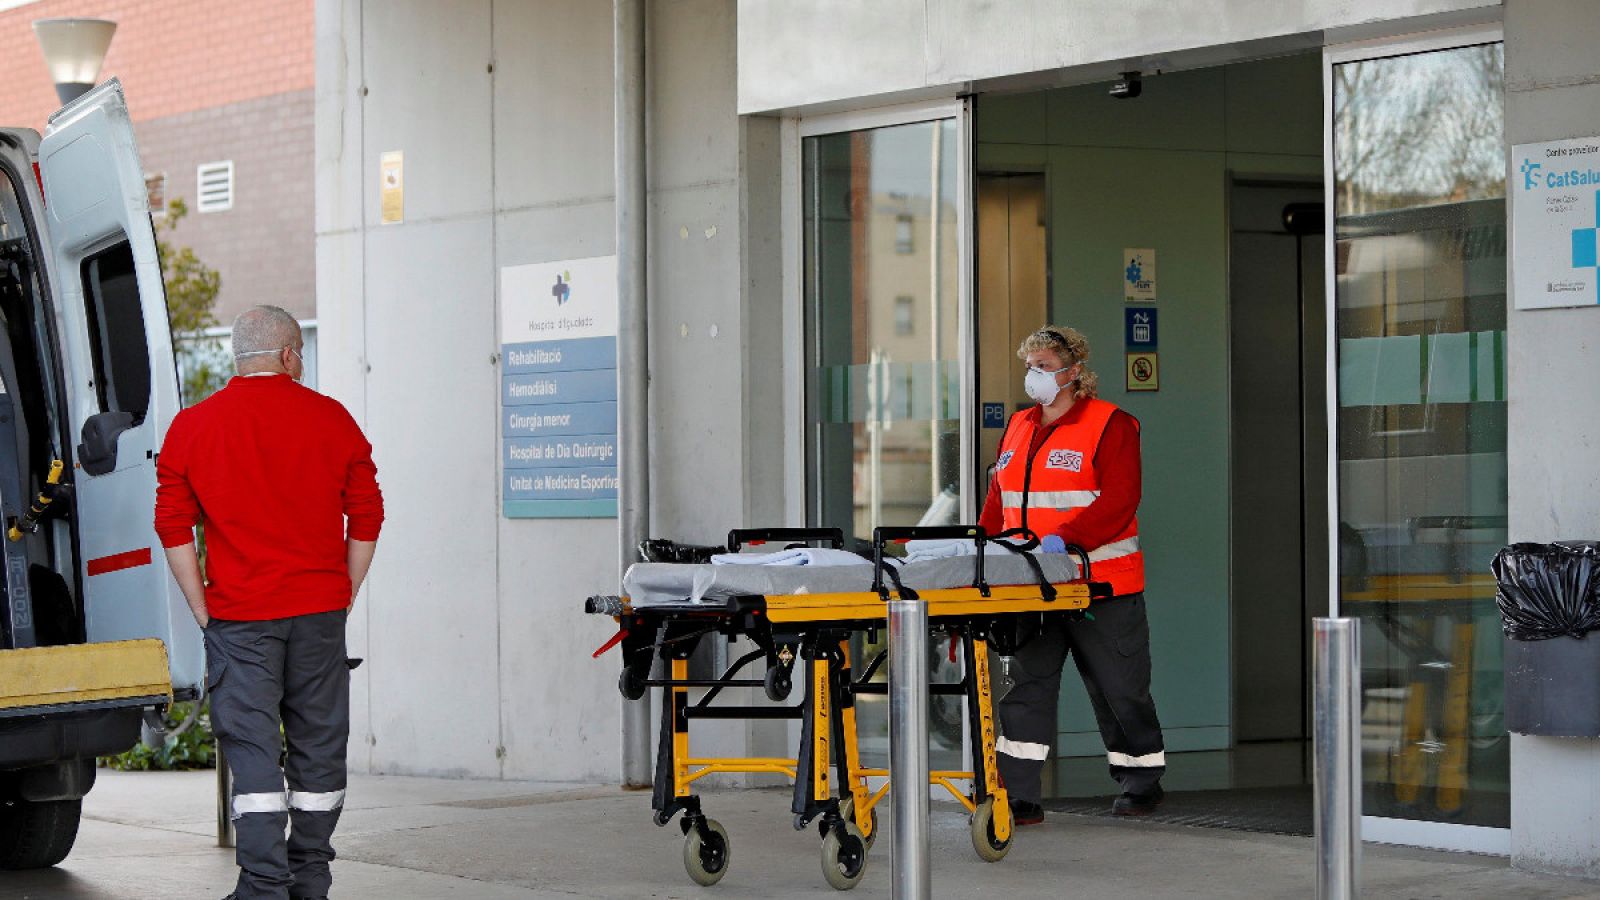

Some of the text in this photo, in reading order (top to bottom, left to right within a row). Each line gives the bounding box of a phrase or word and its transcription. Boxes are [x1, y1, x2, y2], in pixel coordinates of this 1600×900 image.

[509, 348, 561, 366] Rehabilitació
[510, 413, 571, 431] Cirurgia menor
[985, 406, 1003, 420] PB
[510, 444, 542, 462] Hospital
[544, 443, 555, 459] de
[556, 443, 571, 458] Dia
[510, 473, 619, 492] Unitat de Medicina Esportiva
[11, 561, 28, 625] RICON
